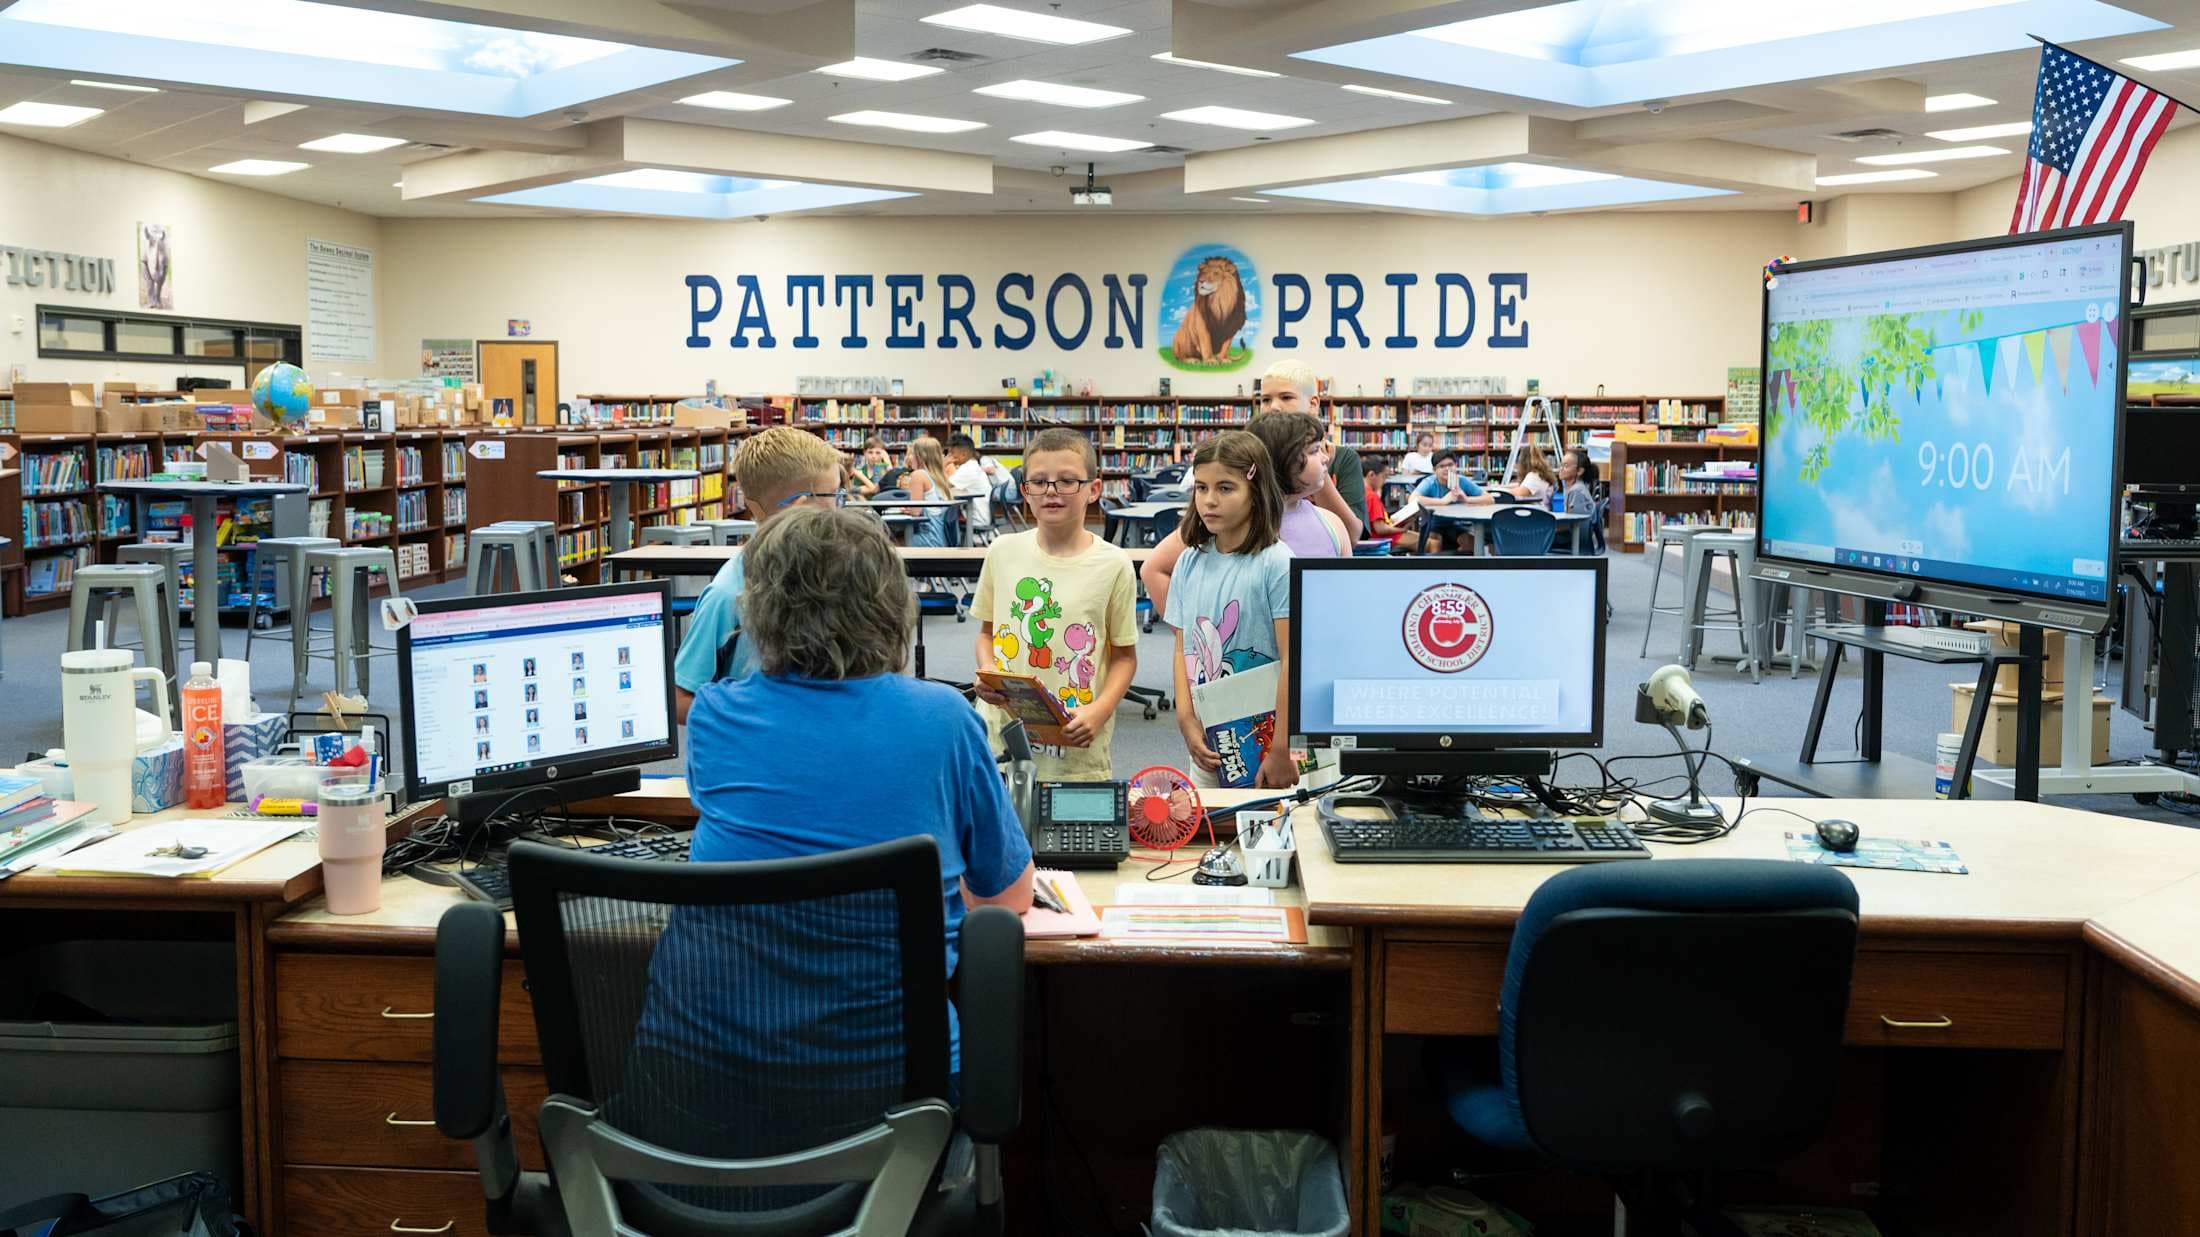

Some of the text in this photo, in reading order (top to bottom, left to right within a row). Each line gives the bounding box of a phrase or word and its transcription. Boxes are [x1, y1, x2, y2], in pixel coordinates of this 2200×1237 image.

[0, 245, 115, 294] ICTION
[685, 272, 1528, 351] PATTERSON PRIDE
[1918, 441, 2071, 495] 9:00 AM
[1431, 600, 1466, 616] 8:59
[1408, 613, 1487, 669] UNIFIED SCHOOL DISTRICT
[1351, 685, 1543, 700] WHERE POTENTIAL
[187, 705, 219, 722] ICE
[1344, 703, 1553, 719] MEETS EXCELLENCE!
[1216, 730, 1233, 754] MAN
[1221, 755, 1241, 783] DOG
